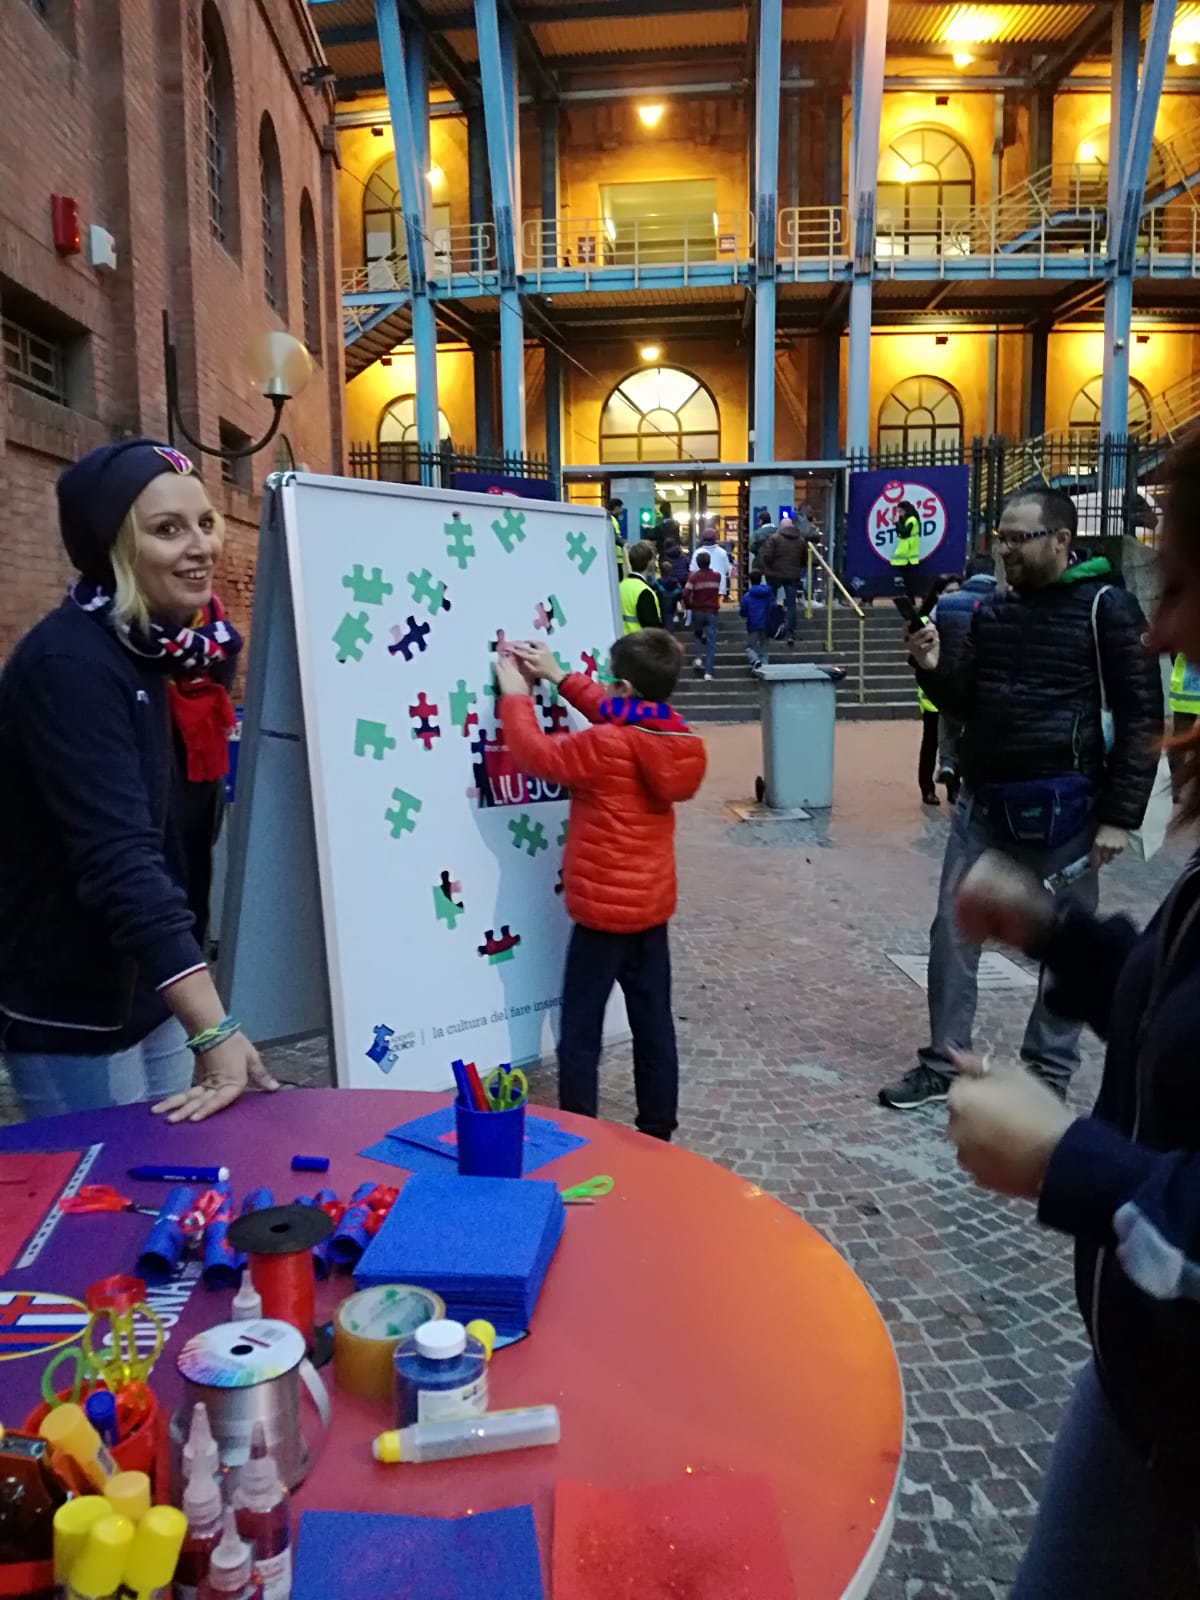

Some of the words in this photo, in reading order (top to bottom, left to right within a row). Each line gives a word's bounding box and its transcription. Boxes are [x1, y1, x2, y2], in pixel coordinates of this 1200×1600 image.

[876, 497, 937, 529] KI'S
[875, 520, 936, 547] STD
[432, 1026, 444, 1039] la
[446, 1016, 488, 1036] cultura
[490, 1008, 509, 1023] del
[510, 1004, 532, 1018] fare
